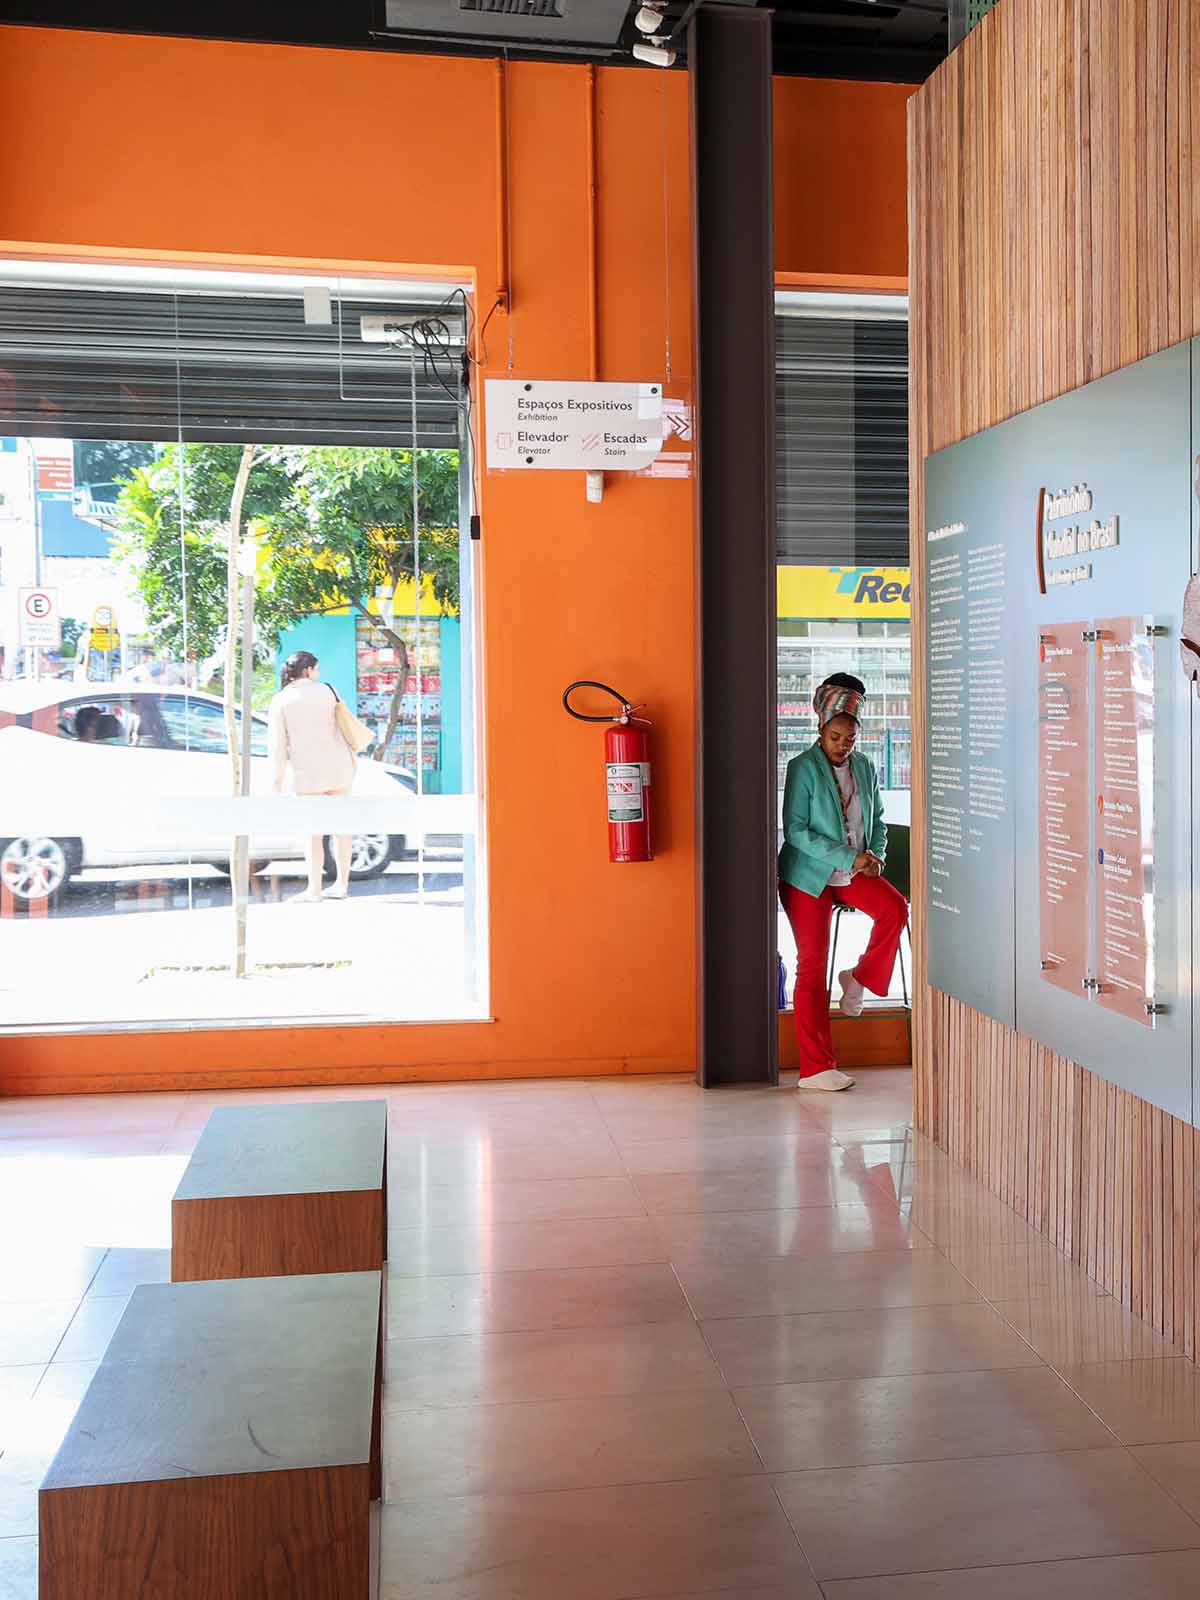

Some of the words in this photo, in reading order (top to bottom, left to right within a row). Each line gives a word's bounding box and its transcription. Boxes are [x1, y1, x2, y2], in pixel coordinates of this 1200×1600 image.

[518, 398, 564, 411] Espaços
[567, 399, 633, 412] Expositivos
[518, 412, 559, 421] Exhibition
[517, 431, 569, 442] Elevador
[603, 432, 648, 444] Escadas
[518, 446, 551, 455] Elevator
[604, 447, 627, 456] Stairs
[34, 599, 44, 613] E
